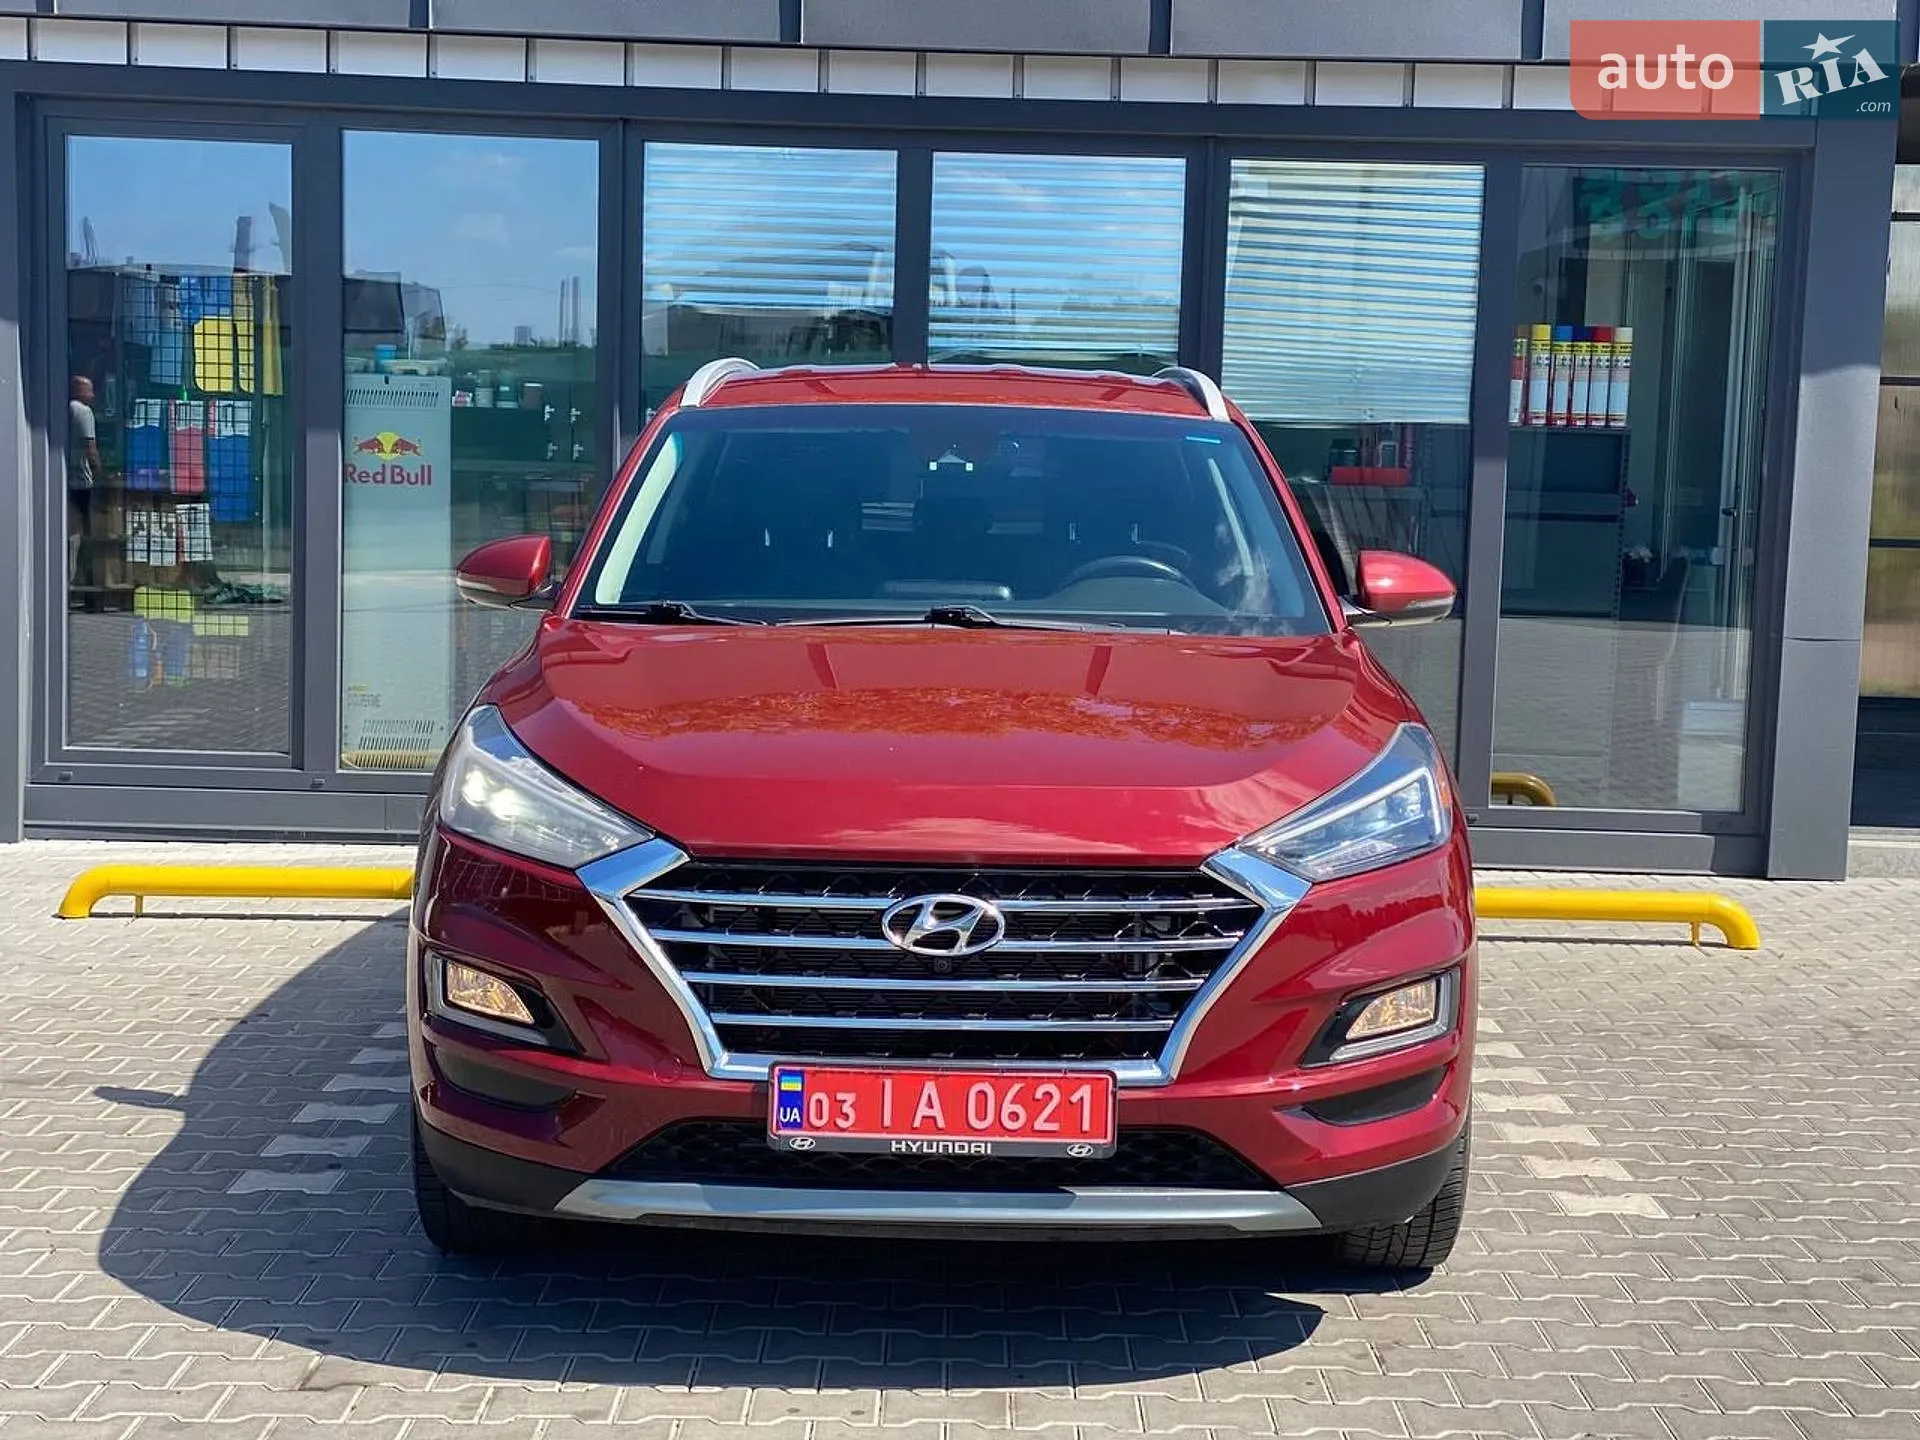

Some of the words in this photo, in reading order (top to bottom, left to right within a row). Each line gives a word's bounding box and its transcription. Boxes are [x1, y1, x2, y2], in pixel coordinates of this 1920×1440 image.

[344, 463, 386, 485] Red
[390, 464, 432, 486] Bull
[780, 1107, 801, 1123] UA
[808, 1092, 857, 1129] 03
[967, 1081, 1092, 1133] 0621
[891, 1140, 992, 1155] HYUNDAI
